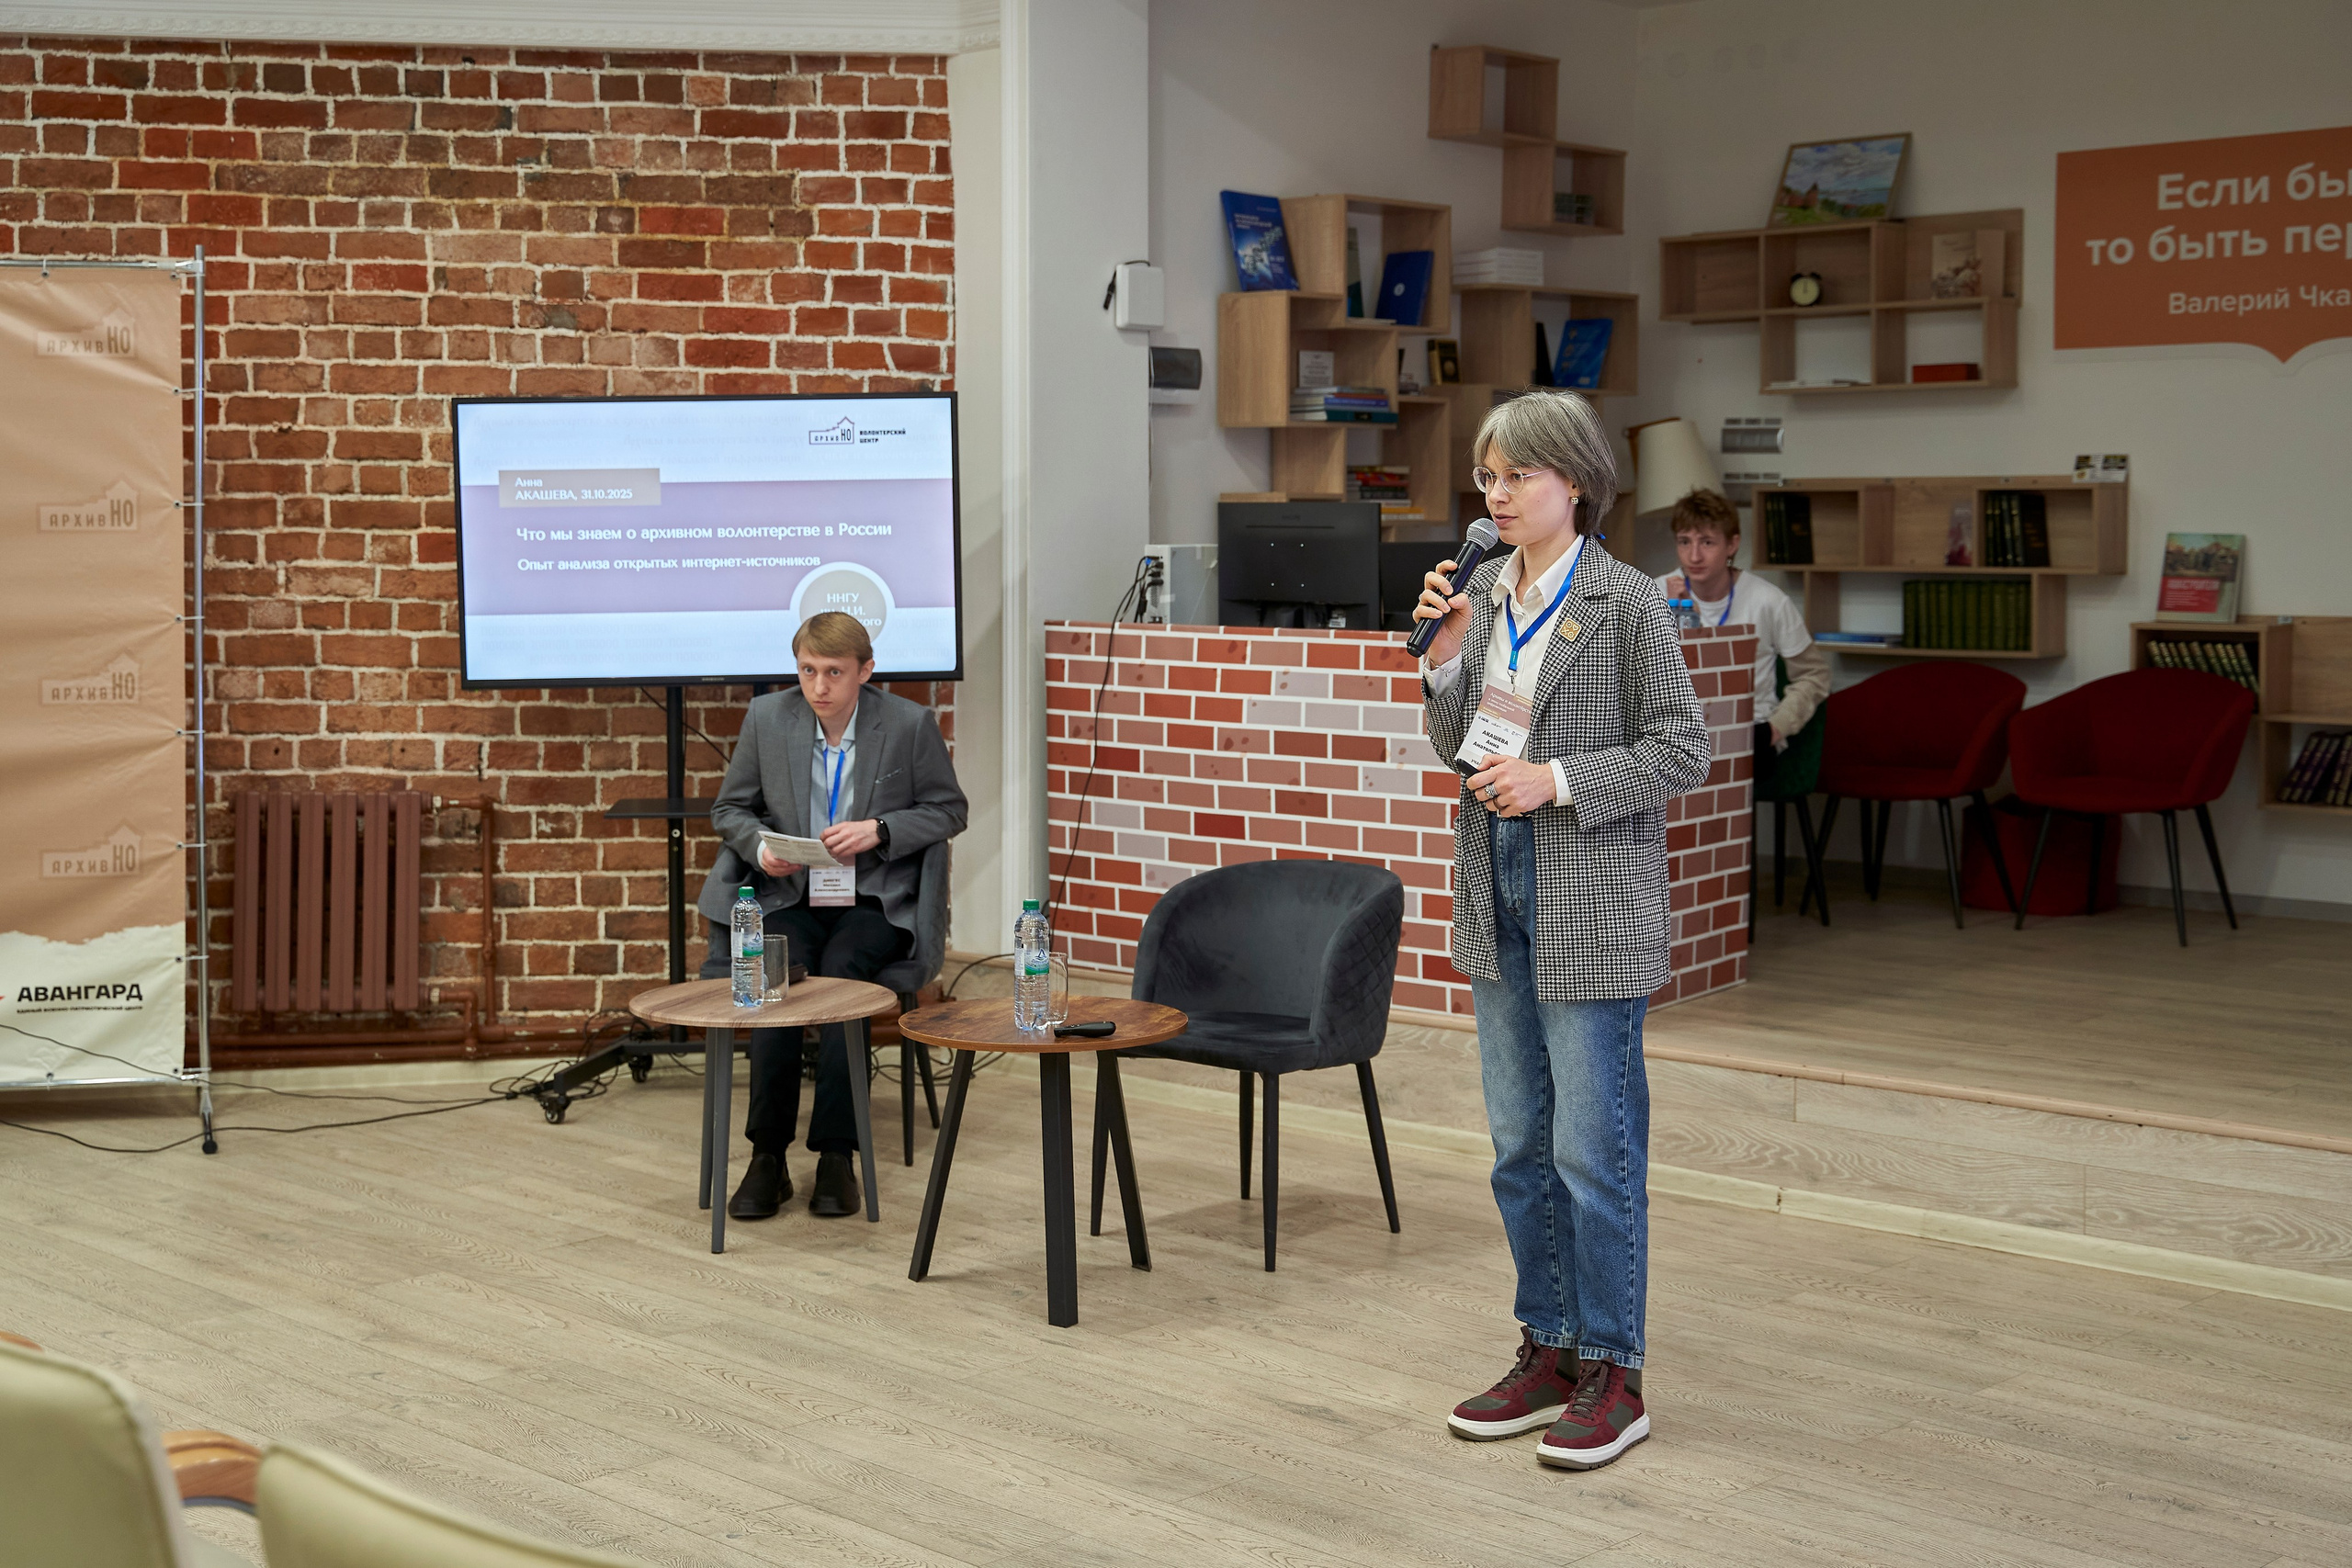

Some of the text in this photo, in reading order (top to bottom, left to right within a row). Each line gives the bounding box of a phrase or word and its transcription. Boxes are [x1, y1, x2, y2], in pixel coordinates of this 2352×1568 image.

[2157, 172, 2270, 211] Если
[2086, 237, 2134, 266] то
[2148, 224, 2268, 264] быть
[2168, 287, 2290, 317] Валерий
[514, 477, 543, 488] Анна
[514, 488, 634, 501] АКАШЕВА, 31.10.2025
[516, 523, 892, 543] Что мы знаем о архивном волонтерстве в России
[517, 556, 821, 572] Опыт анализа открытых интернет-источников
[826, 592, 860, 604] ННГУ
[1482, 729, 1509, 746] АКАШЕВА
[1486, 739, 1499, 750] Анна
[17, 983, 143, 1002] АВАНГАРД
